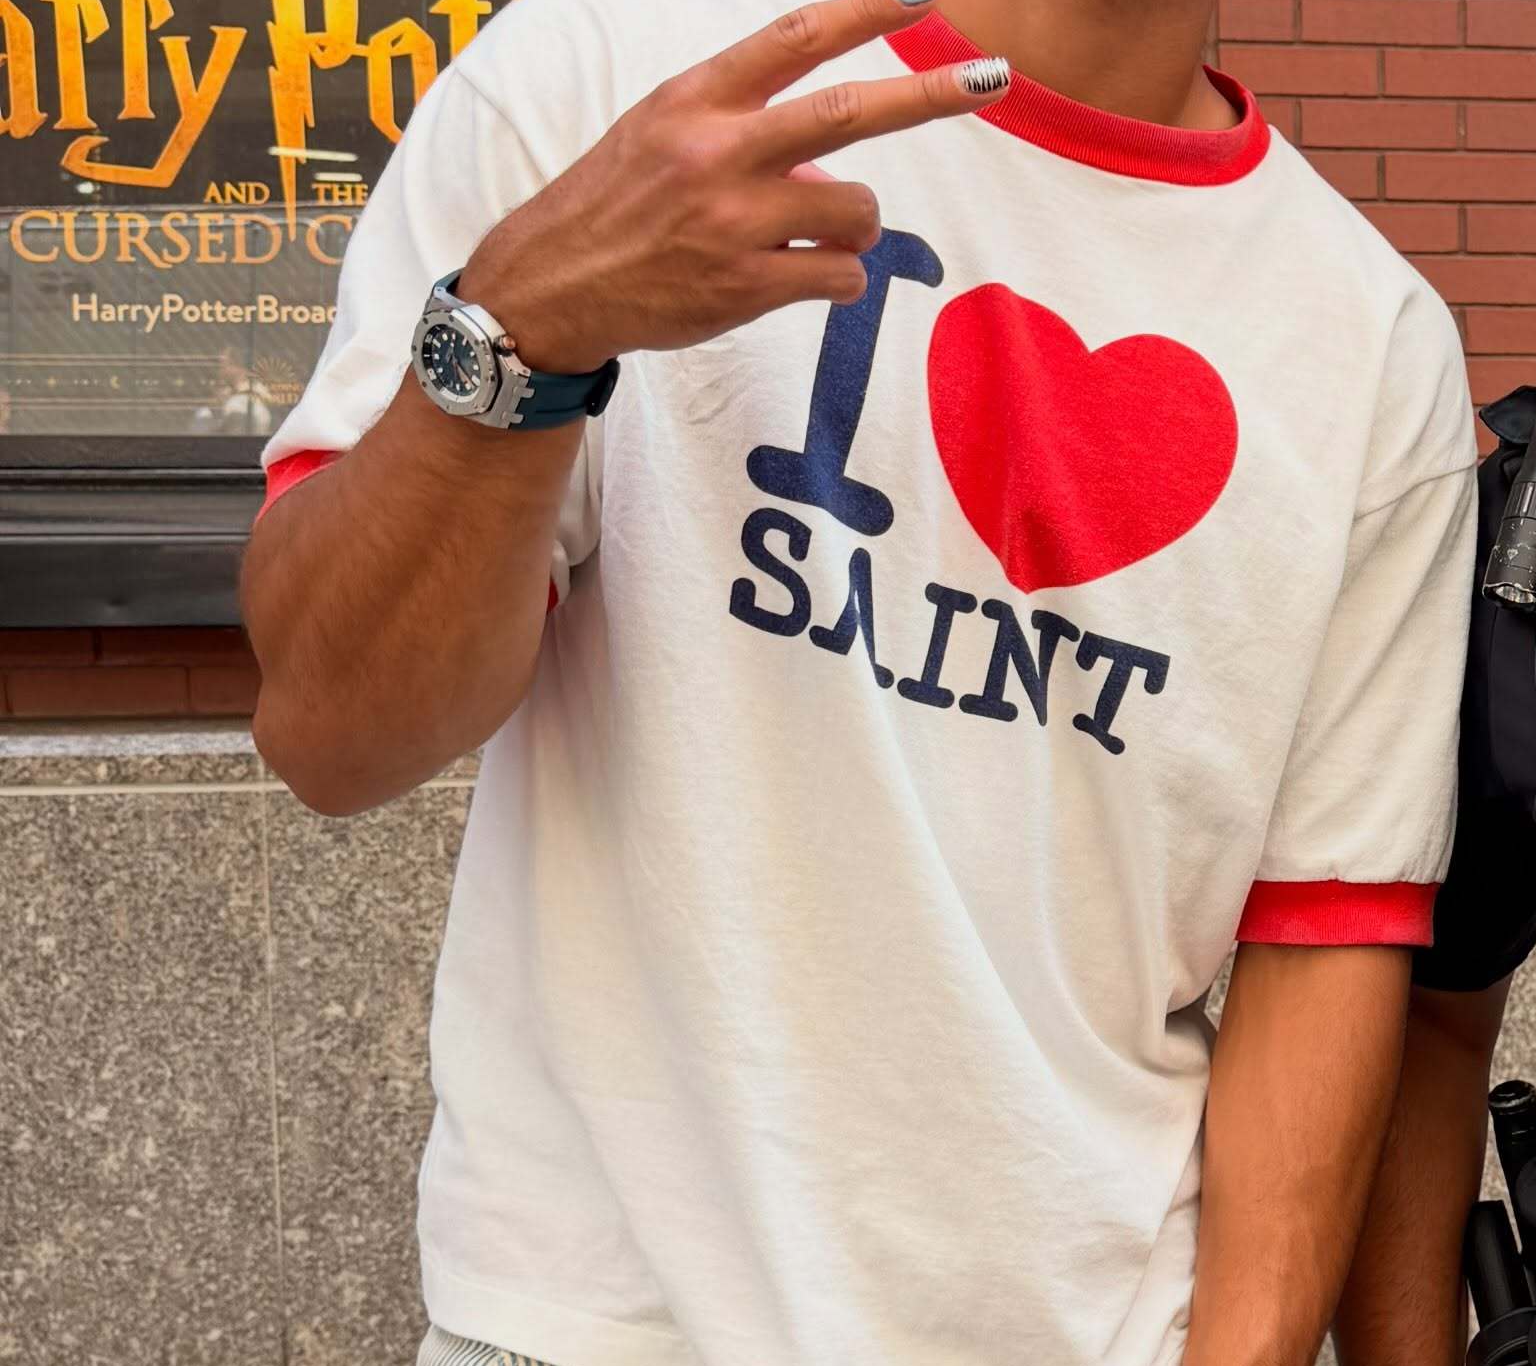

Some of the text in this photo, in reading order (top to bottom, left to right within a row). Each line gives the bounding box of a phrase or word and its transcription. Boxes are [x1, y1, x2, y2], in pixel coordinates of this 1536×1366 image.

[9, 210, 283, 269] CURSED
[203, 181, 369, 206] AND THE
[746, 226, 944, 537] I
[729, 507, 1171, 756] SAINT
